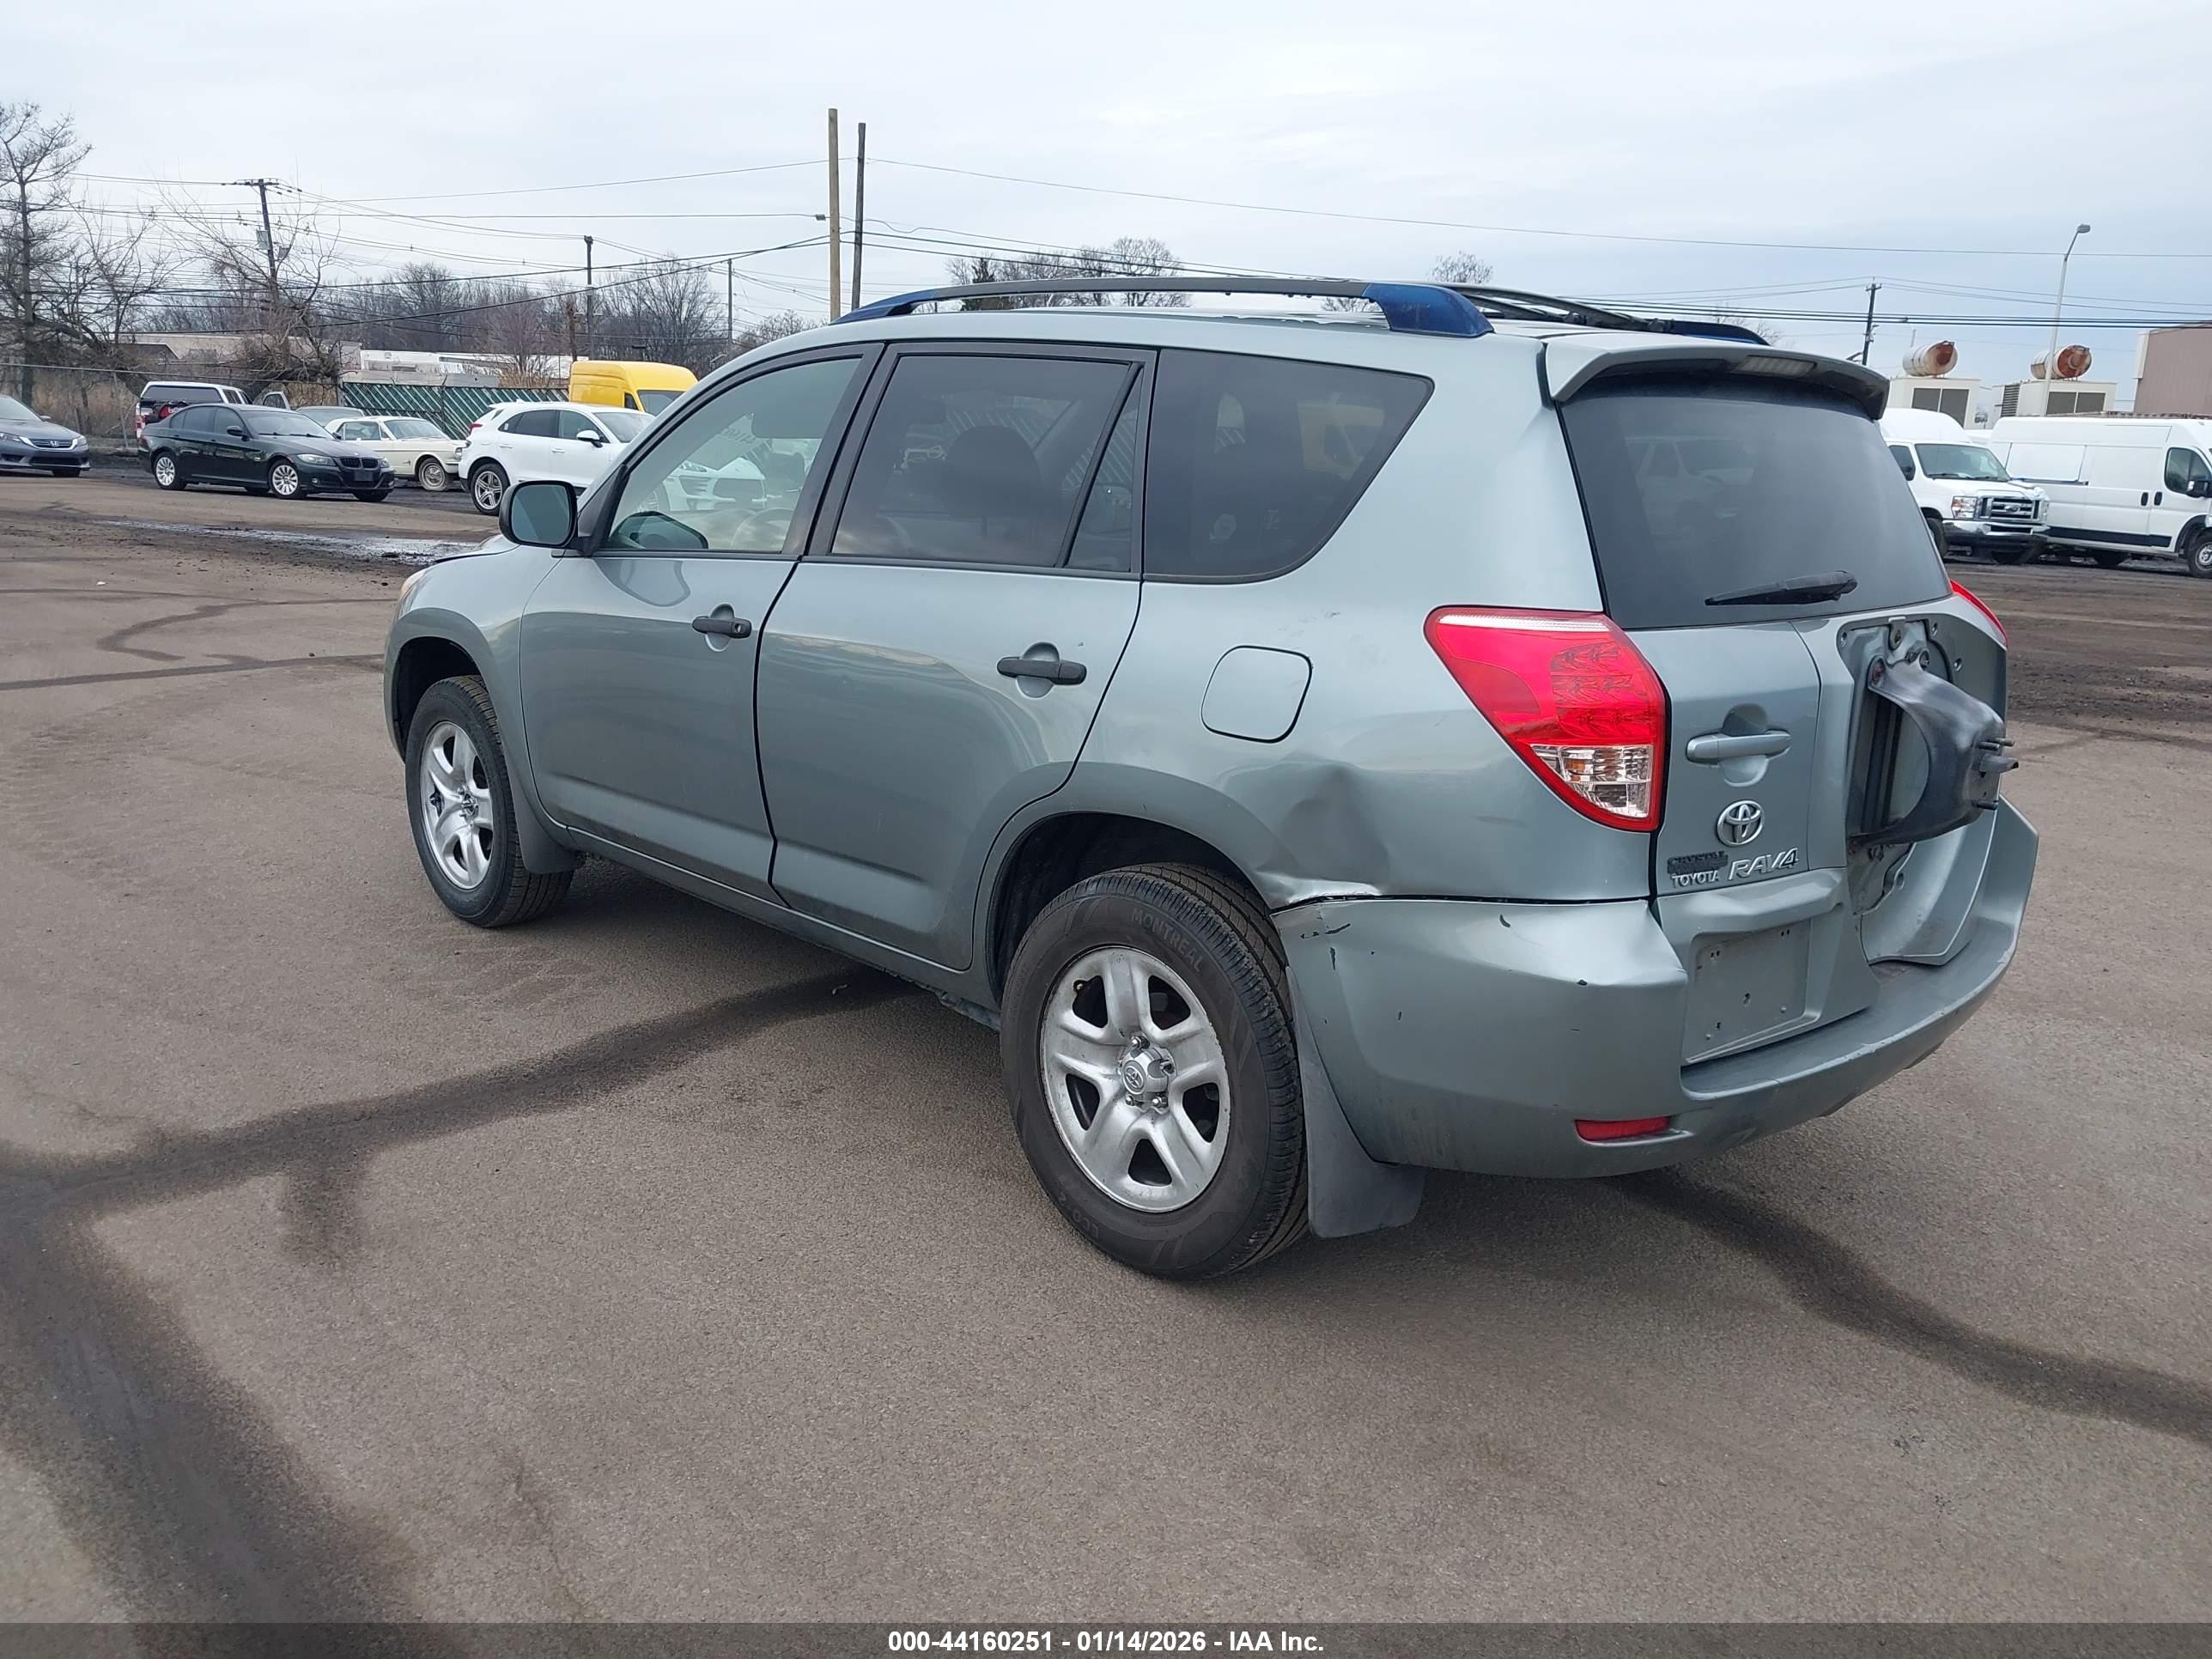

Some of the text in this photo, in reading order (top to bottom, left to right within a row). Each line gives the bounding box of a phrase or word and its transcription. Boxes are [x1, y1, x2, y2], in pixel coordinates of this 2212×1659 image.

[1671, 869, 1719, 888] TOYOTA
[1728, 847, 1800, 881] RAV4
[1131, 907, 1204, 972] MONTREAL
